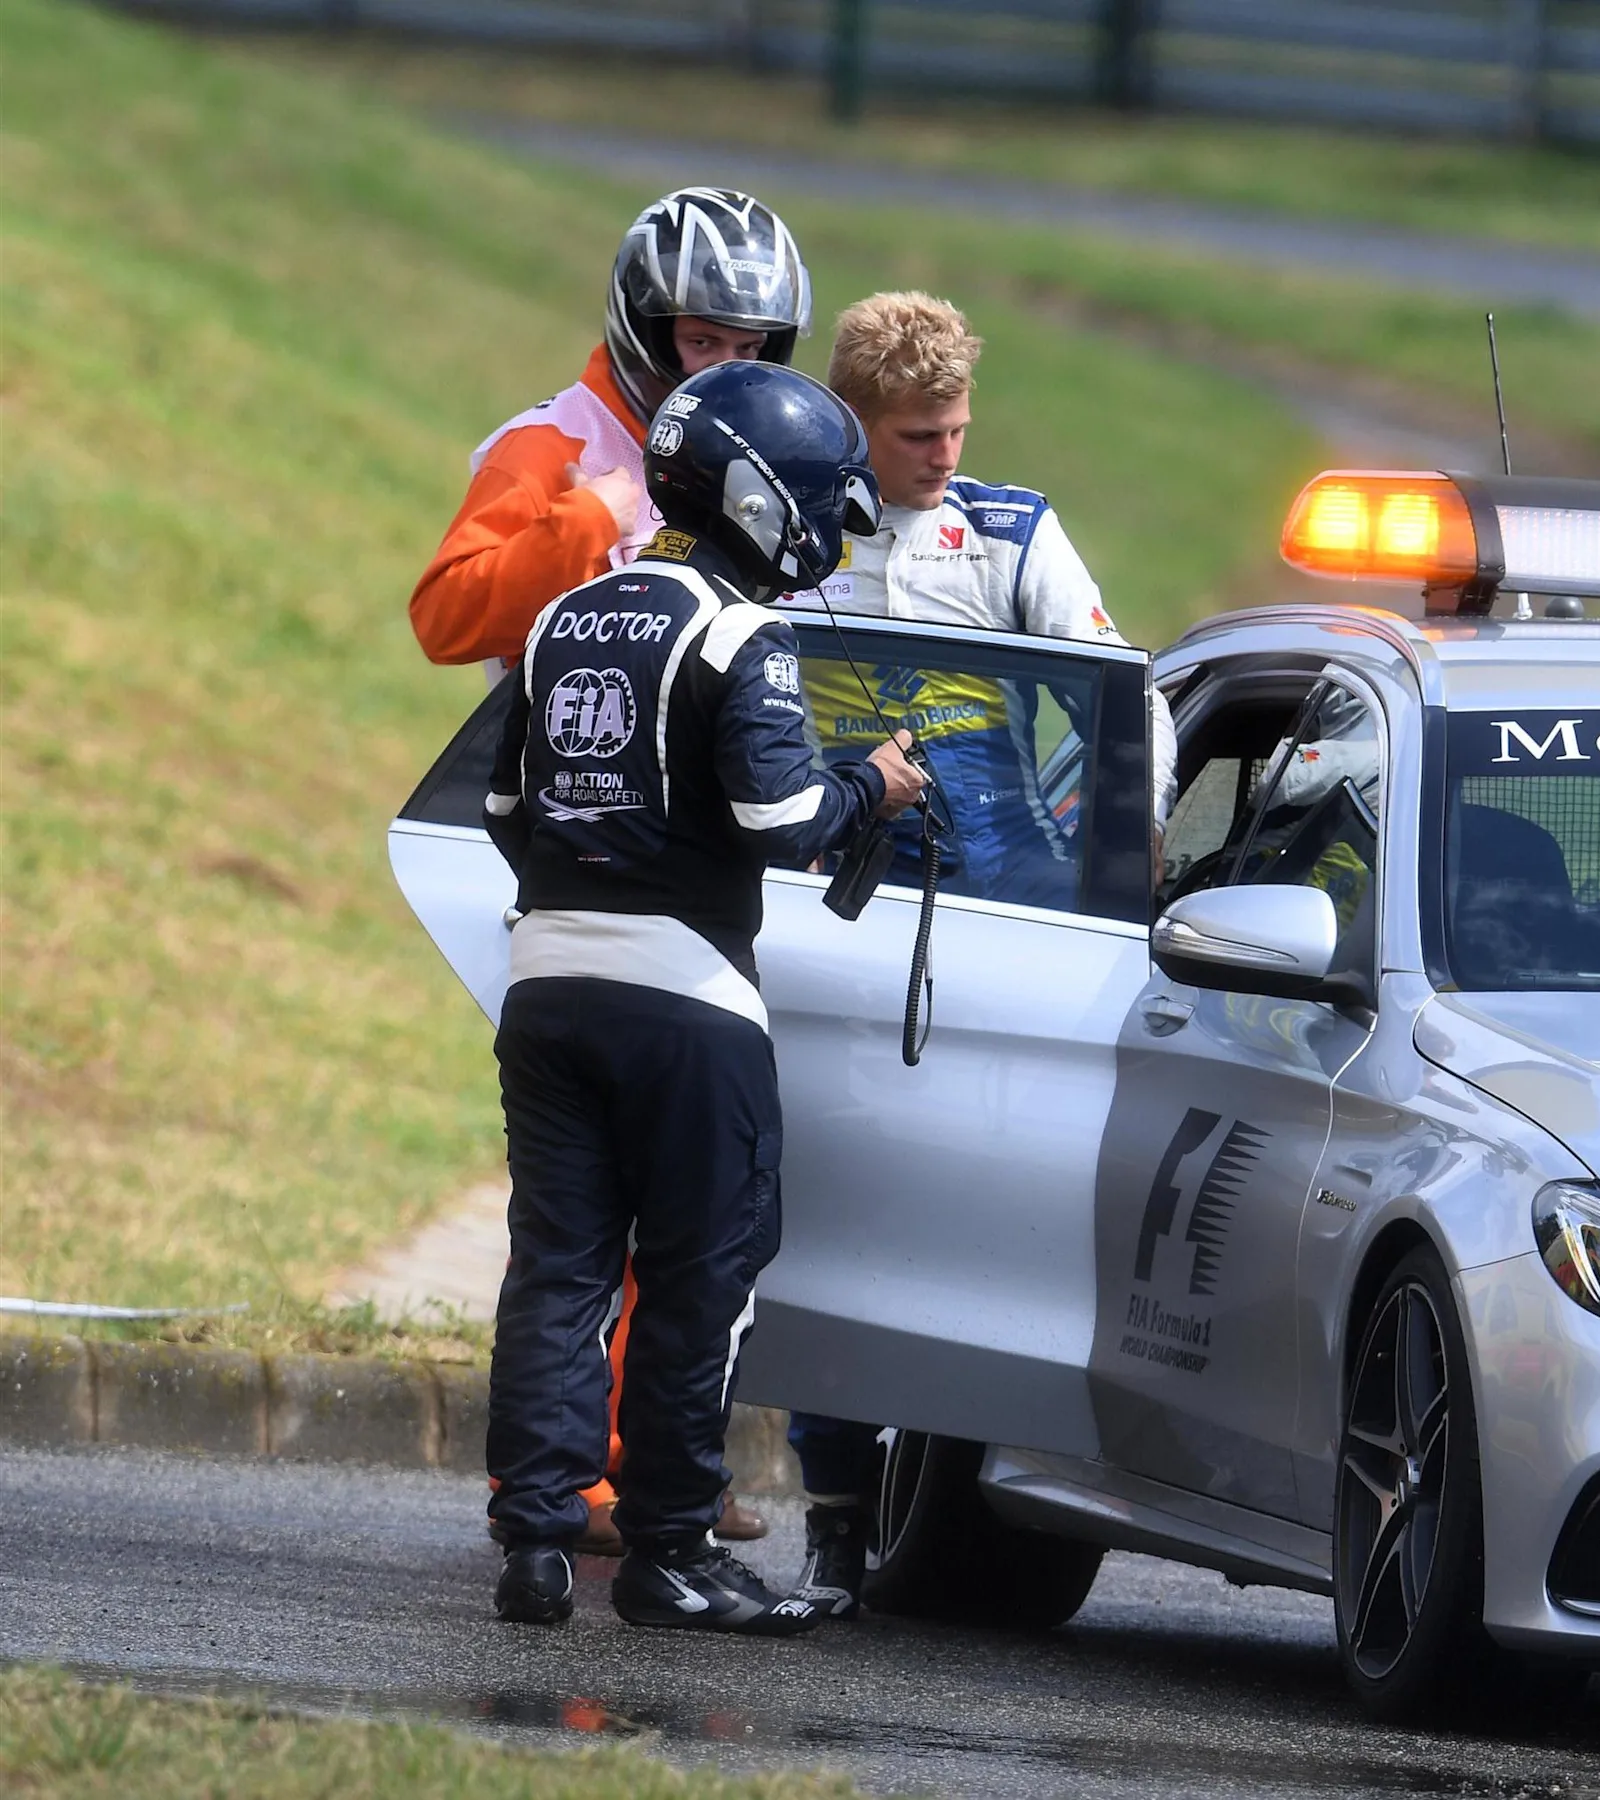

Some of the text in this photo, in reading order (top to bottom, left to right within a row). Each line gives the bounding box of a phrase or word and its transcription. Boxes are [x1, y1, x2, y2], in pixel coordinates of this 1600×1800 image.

[667, 396, 699, 414] OMP
[730, 434, 750, 448] JET
[983, 513, 1017, 526] OMP
[911, 553, 946, 562] Sauber
[964, 553, 989, 561] Team
[551, 611, 672, 643] DOCTOR
[575, 773, 624, 789] ACTION
[554, 789, 644, 804] FOR ROAD SAFETY
[1126, 1293, 1212, 1348] FIA Formula 1
[1120, 1335, 1207, 1374] WORLD CHAMPIONSHIP
